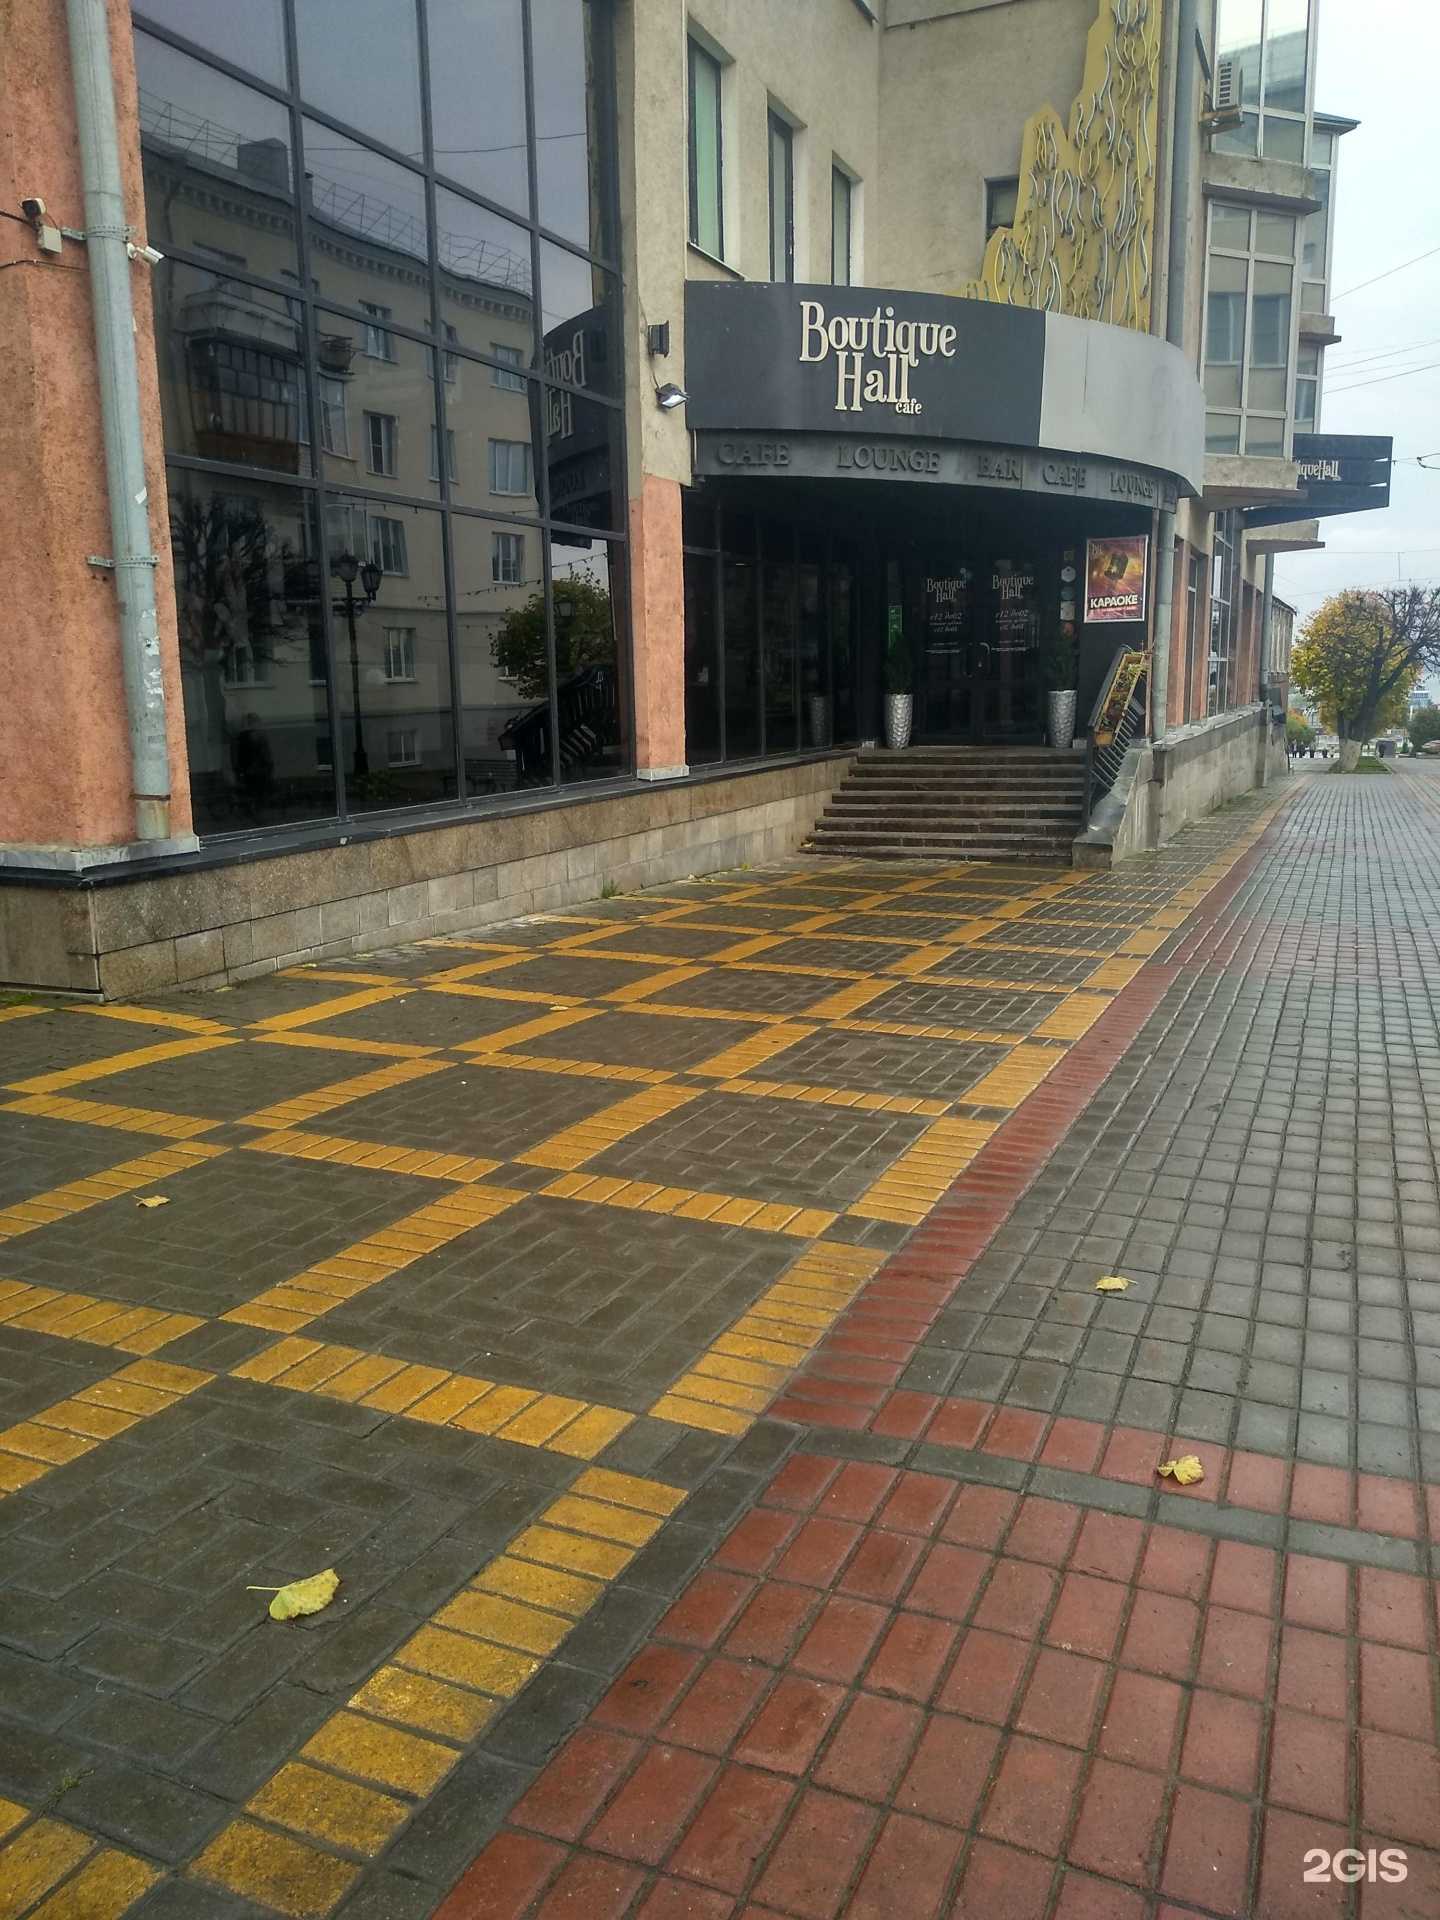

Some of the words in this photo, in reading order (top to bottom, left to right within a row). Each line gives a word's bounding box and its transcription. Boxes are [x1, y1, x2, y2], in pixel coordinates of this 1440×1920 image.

[800, 301, 957, 367] Boutique
[834, 351, 911, 412] Hall
[895, 397, 922, 414] cafe
[717, 442, 791, 466] CAFE
[836, 445, 939, 474] LOUNGE
[977, 455, 1021, 481] BAR
[1043, 463, 1086, 488] CAFE
[1090, 594, 1138, 609] КАРАОКЕ
